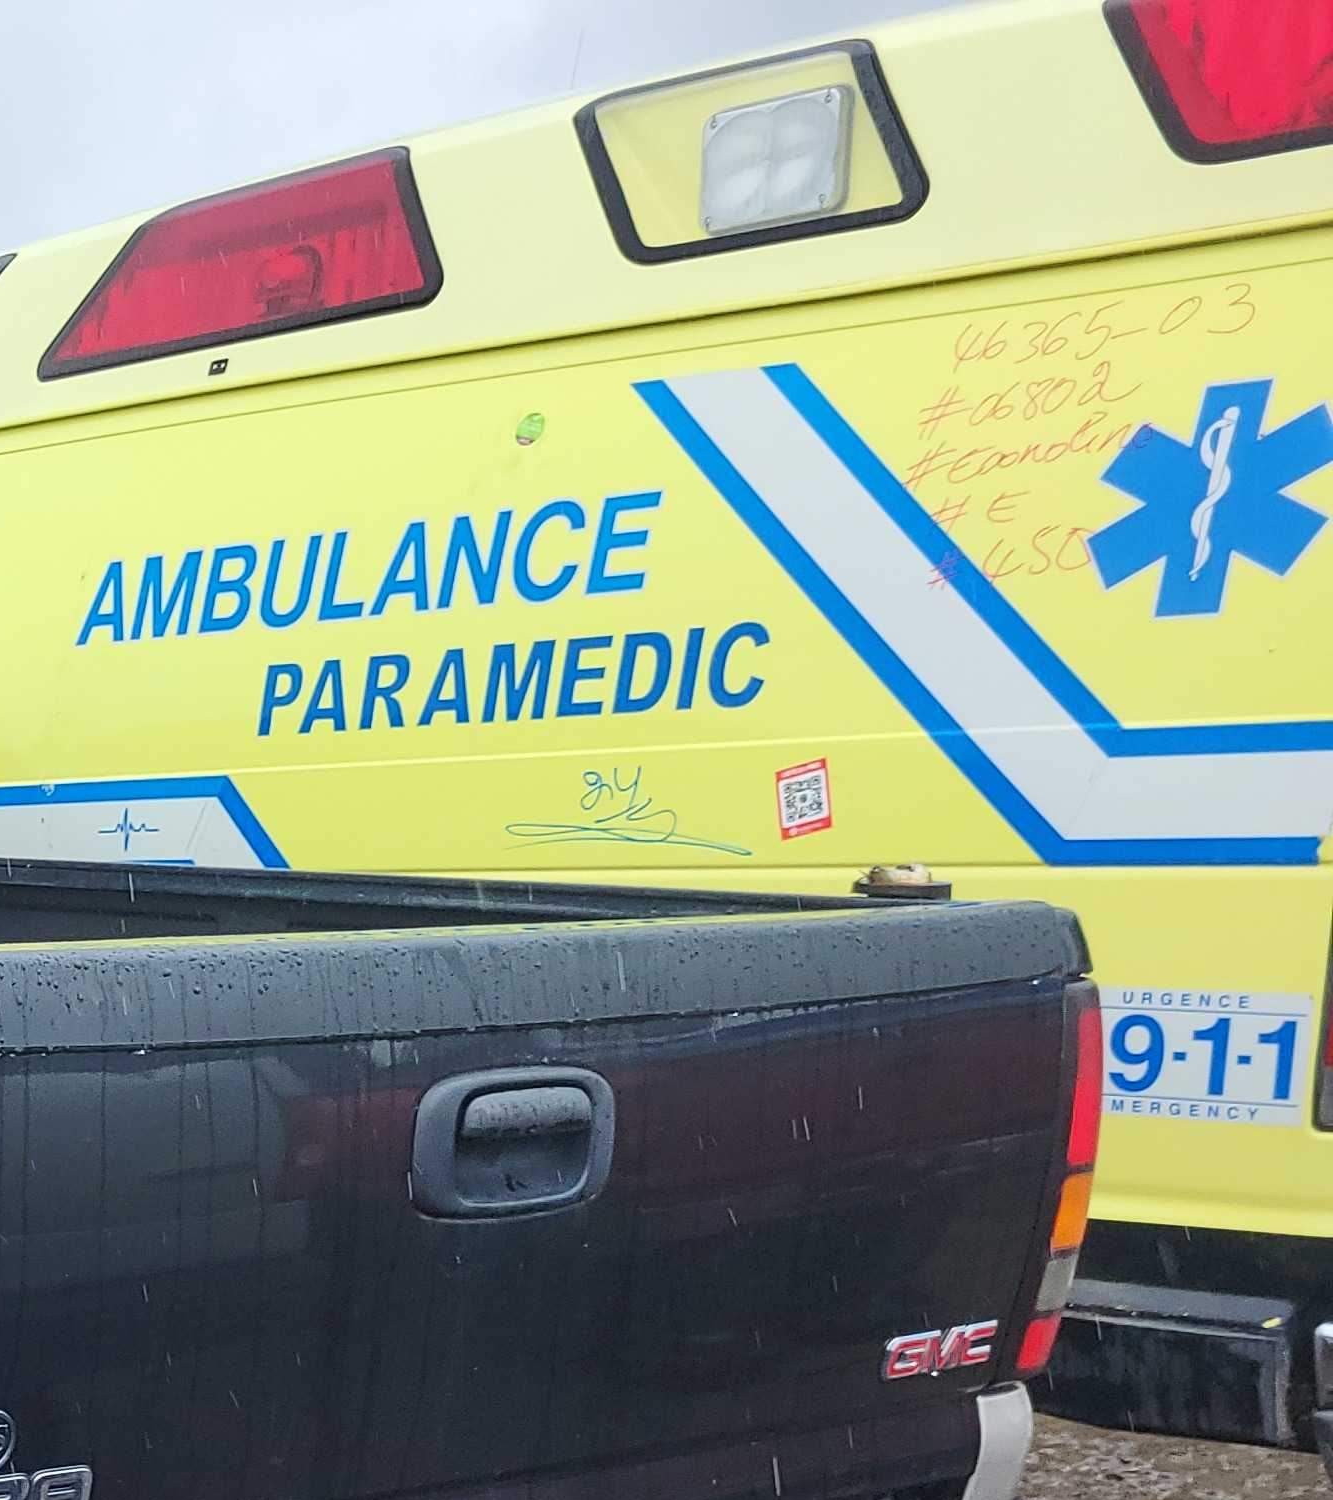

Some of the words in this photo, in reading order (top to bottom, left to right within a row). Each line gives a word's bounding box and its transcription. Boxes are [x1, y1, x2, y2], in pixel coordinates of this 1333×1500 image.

[74, 490, 663, 646] AMBULANCE
[257, 621, 771, 736] PARAMEDIC
[1122, 990, 1252, 1010] URGENCE
[1108, 1013, 1298, 1100] 9-1-1
[1111, 1099, 1260, 1120] MERGENCY
[885, 1319, 999, 1380] GMC
